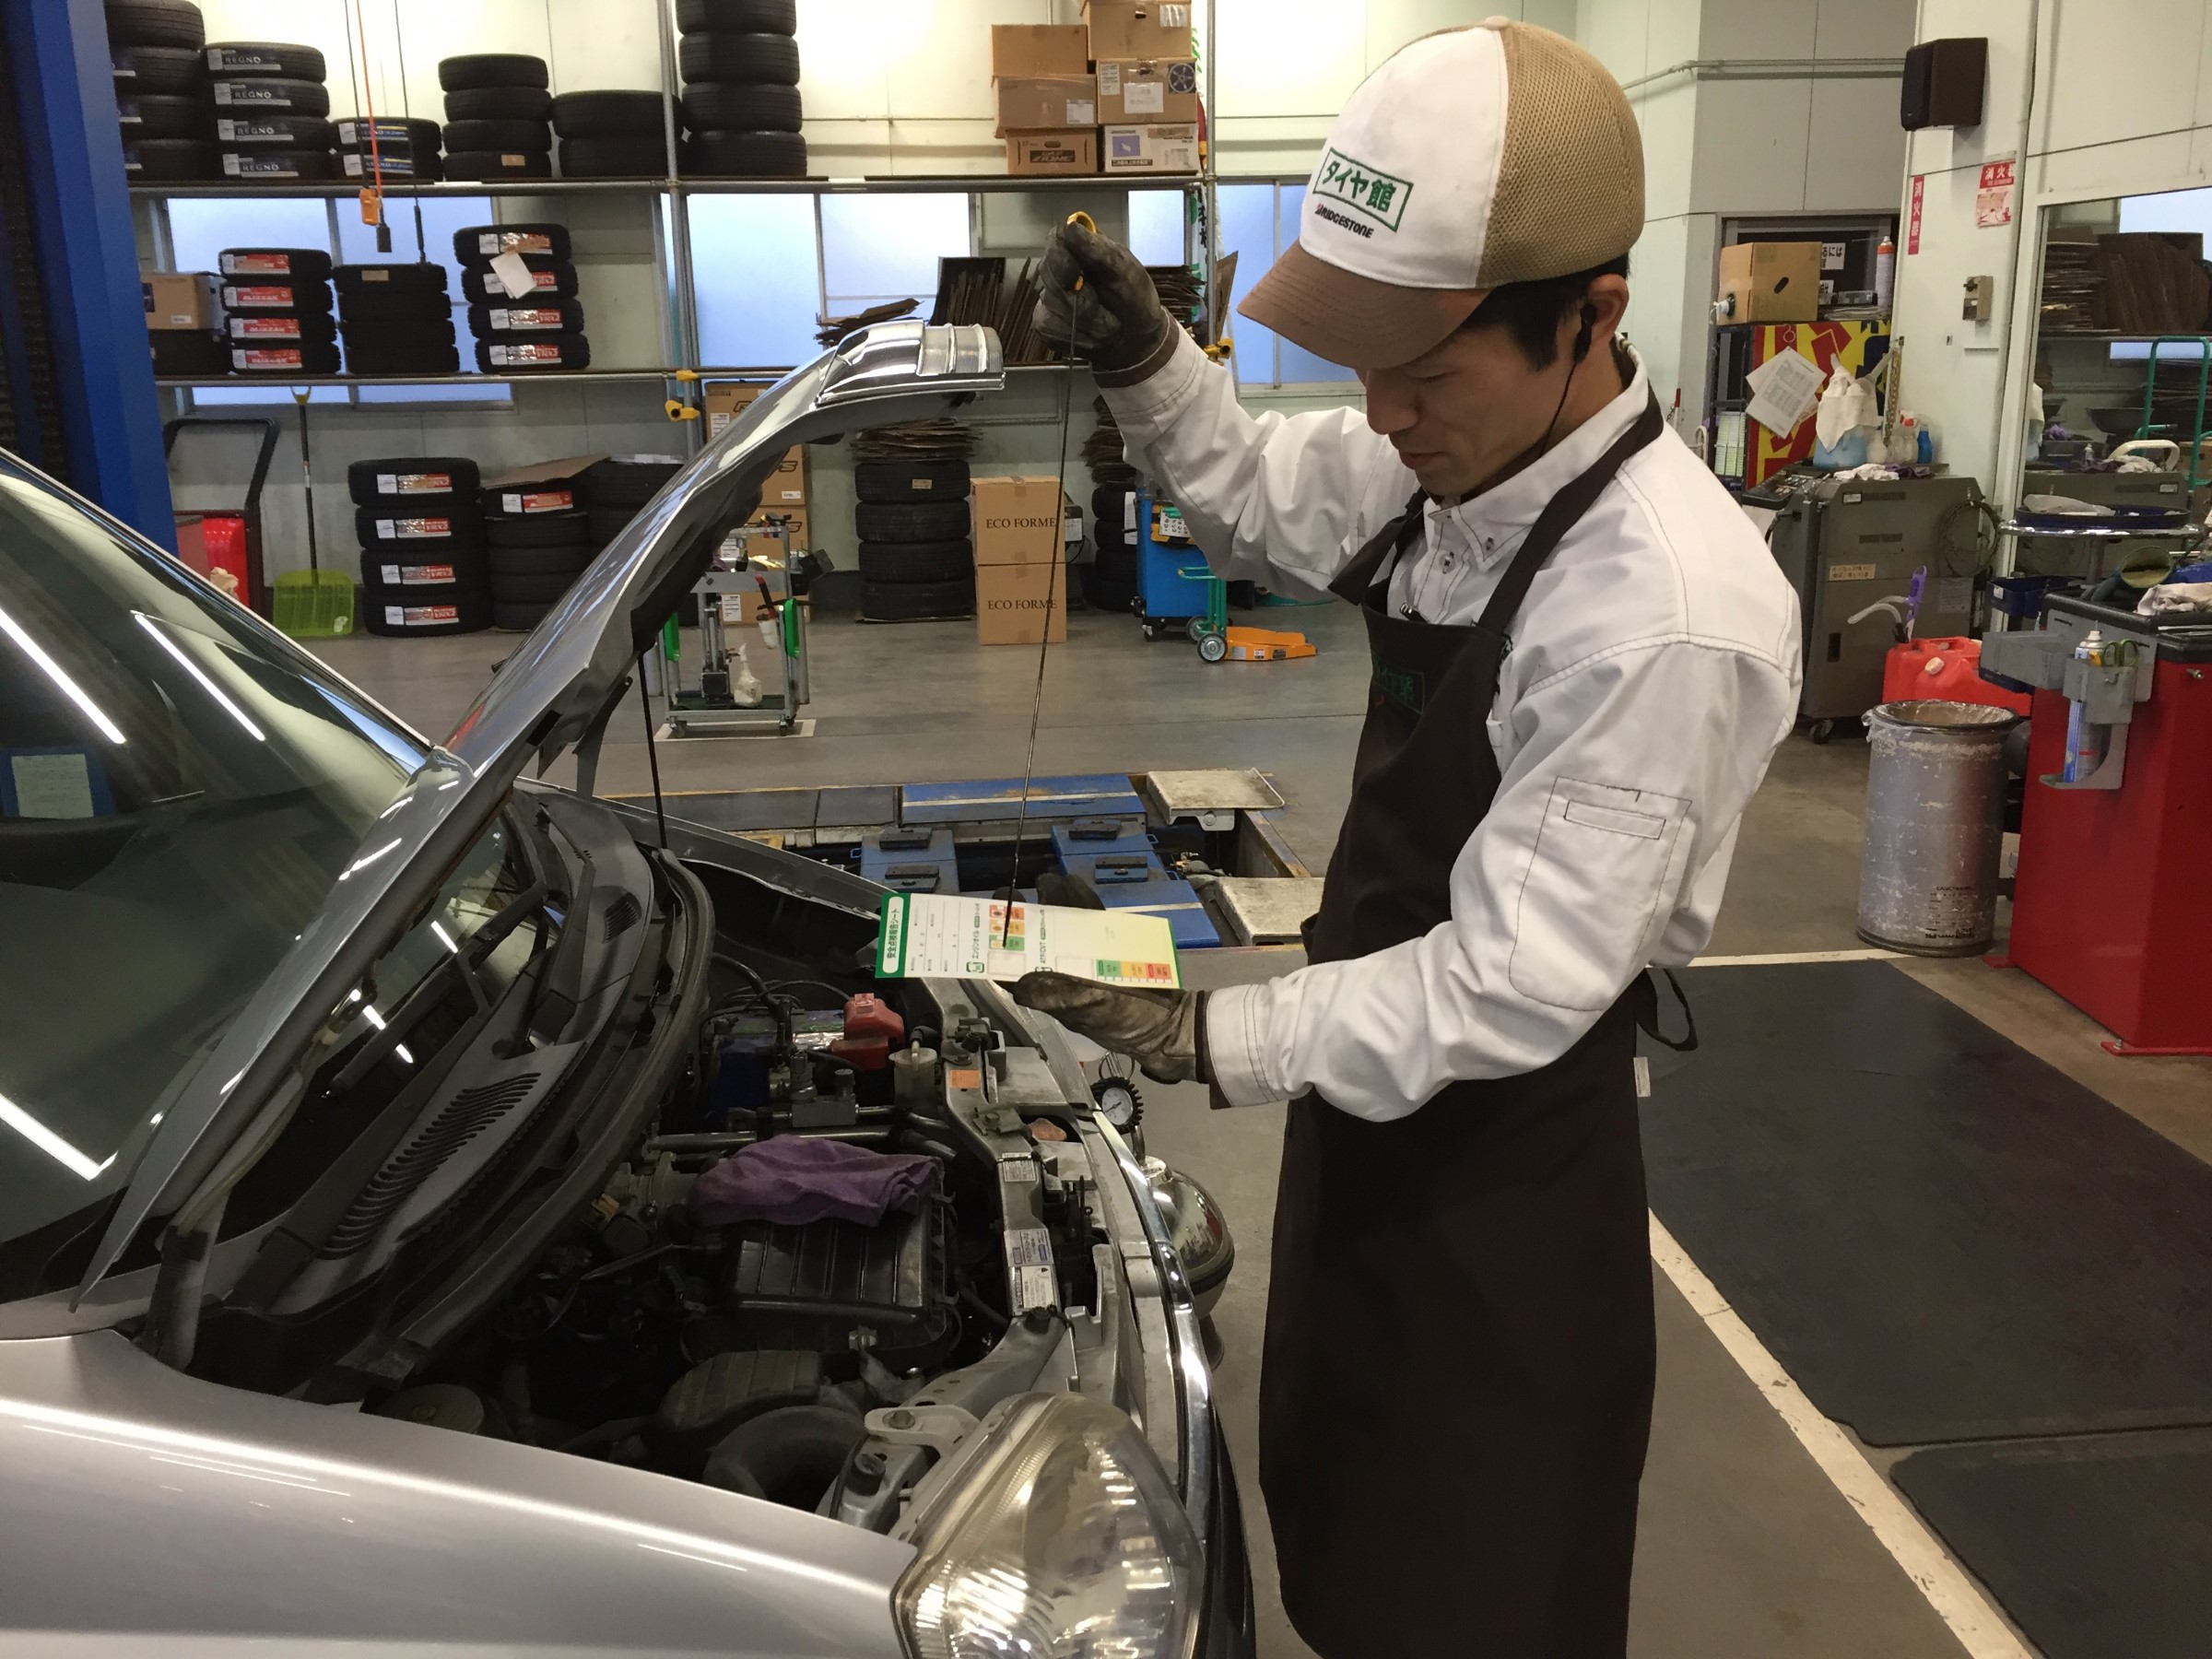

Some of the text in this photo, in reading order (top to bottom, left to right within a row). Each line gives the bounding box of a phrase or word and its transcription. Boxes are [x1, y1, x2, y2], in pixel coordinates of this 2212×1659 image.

[237, 126, 275, 135] REGNO
[1323, 160, 1397, 212] タイヤ館
[1912, 180, 1923, 237] 消火器
[1314, 203, 1374, 239] BRIDGESTONE
[986, 517, 1056, 529] ECO FORME
[988, 599, 1058, 610] ECO FORME
